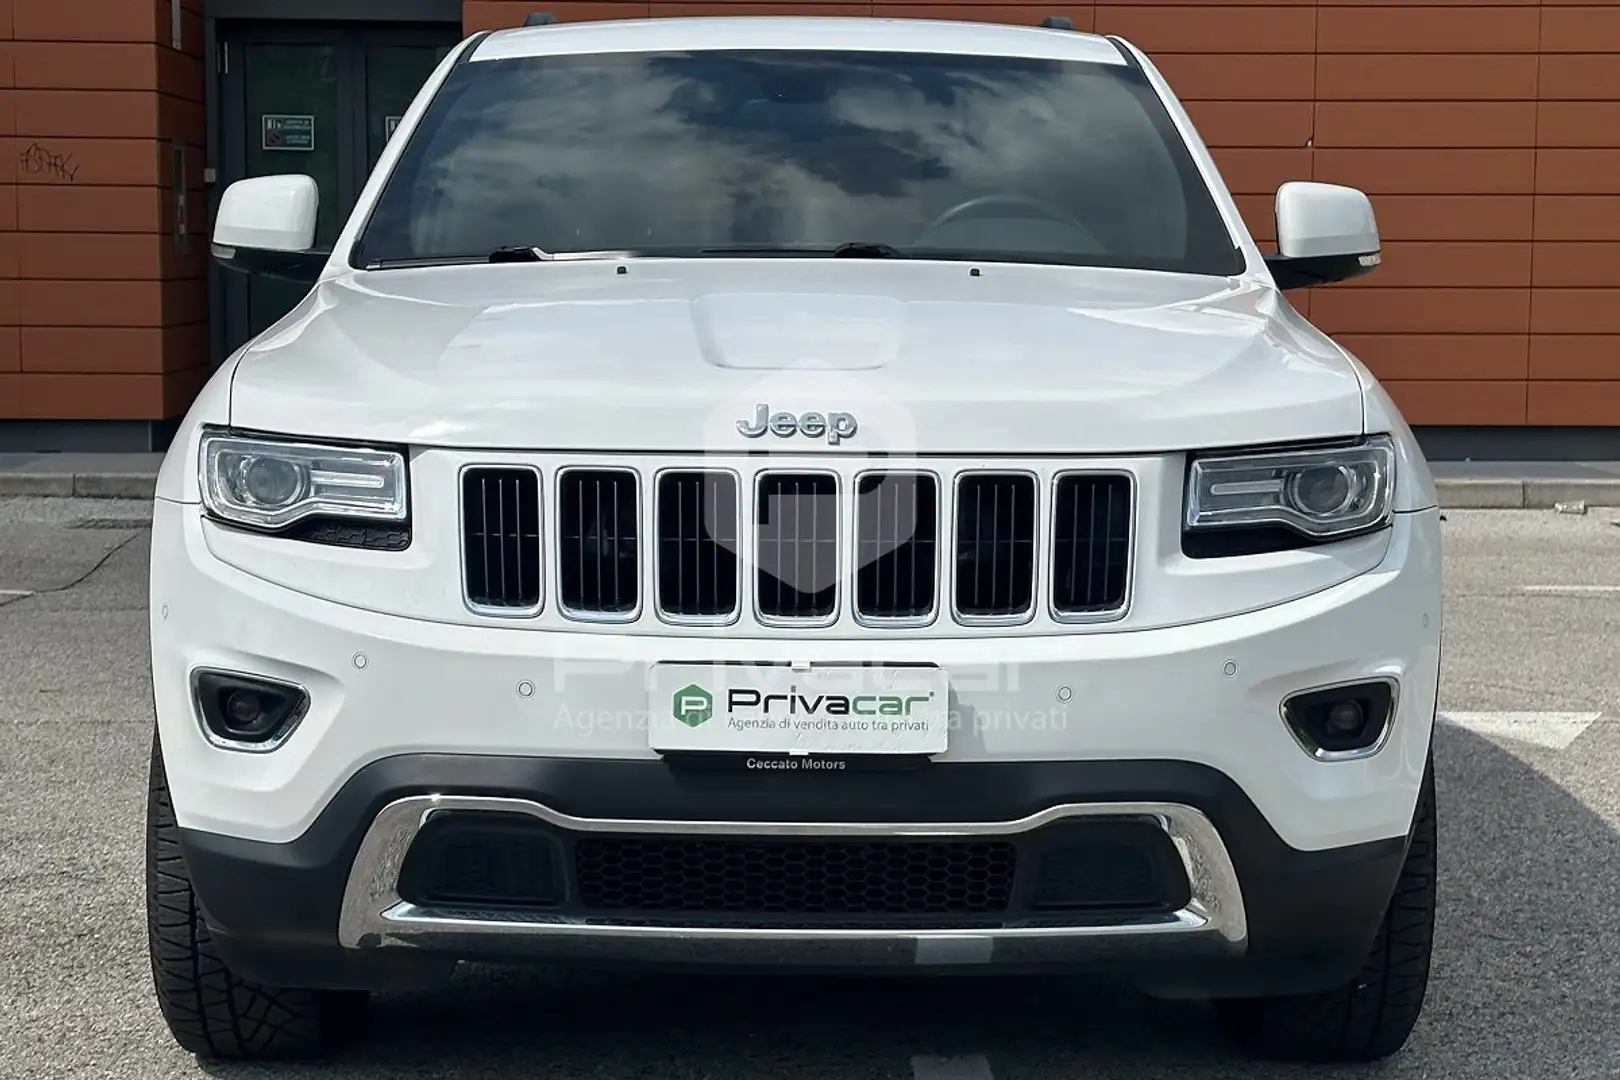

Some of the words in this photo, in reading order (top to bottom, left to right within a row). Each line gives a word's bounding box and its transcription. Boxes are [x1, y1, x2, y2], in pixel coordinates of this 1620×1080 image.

[736, 403, 859, 446] Jeep
[727, 685, 930, 716] Privacar
[727, 717, 776, 731] Agenzia
[779, 718, 791, 729] di
[793, 718, 838, 731] vendita
[841, 721, 868, 731] auto
[872, 720, 888, 730] tra
[891, 720, 929, 732] privati
[746, 757, 798, 769] Ceccato
[801, 758, 846, 770] Motors
